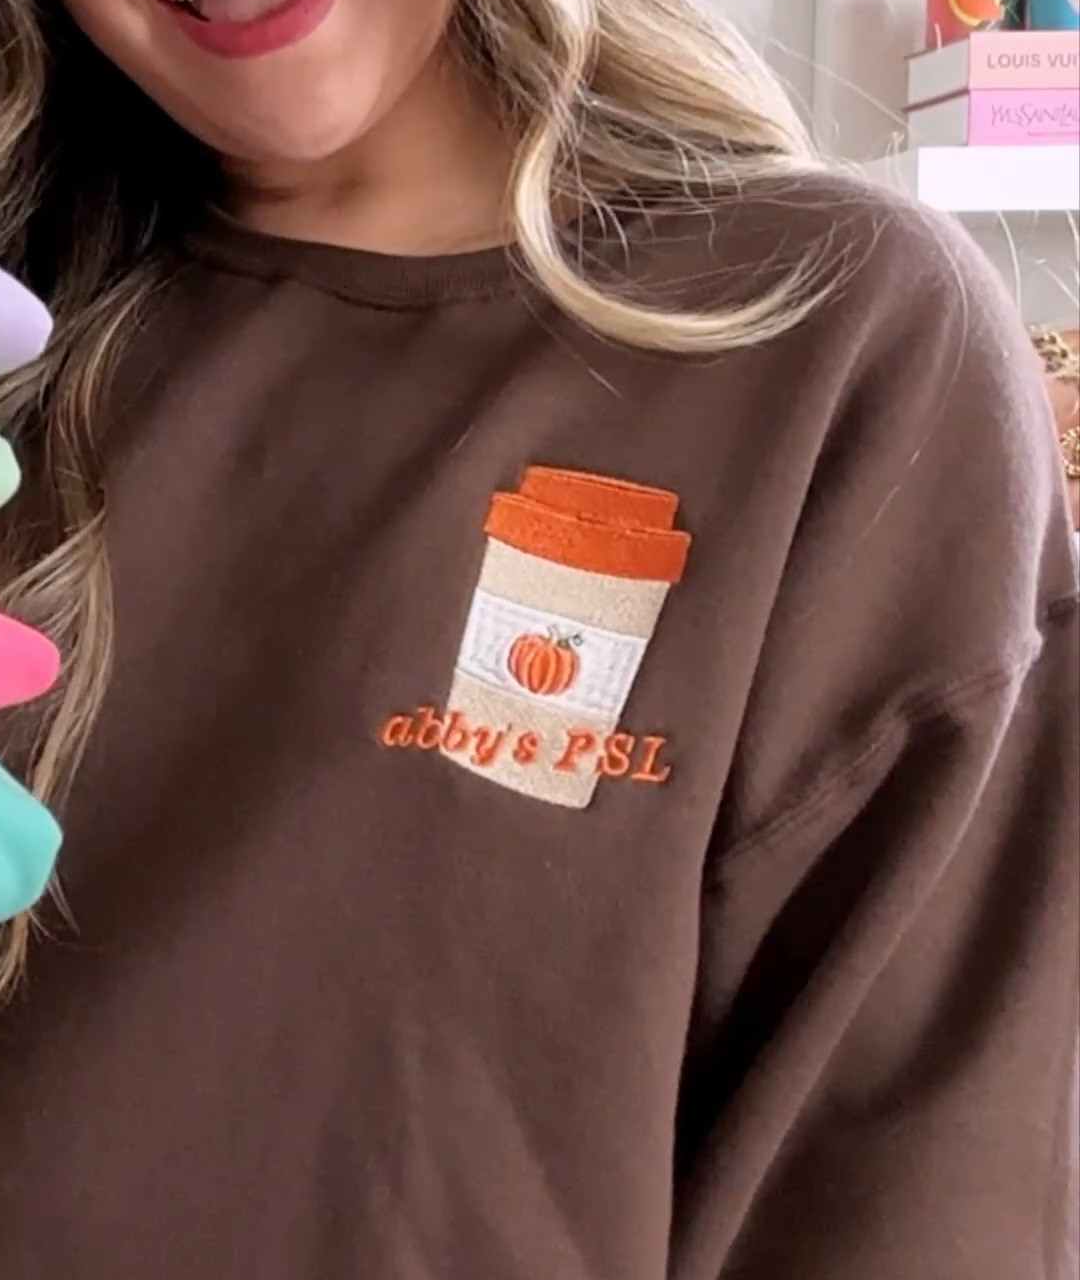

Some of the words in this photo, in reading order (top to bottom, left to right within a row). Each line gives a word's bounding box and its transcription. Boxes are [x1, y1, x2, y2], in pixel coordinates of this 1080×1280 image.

[987, 53, 1041, 69] LOUIS
[380, 704, 541, 766] abby's
[552, 725, 671, 783] PSL
